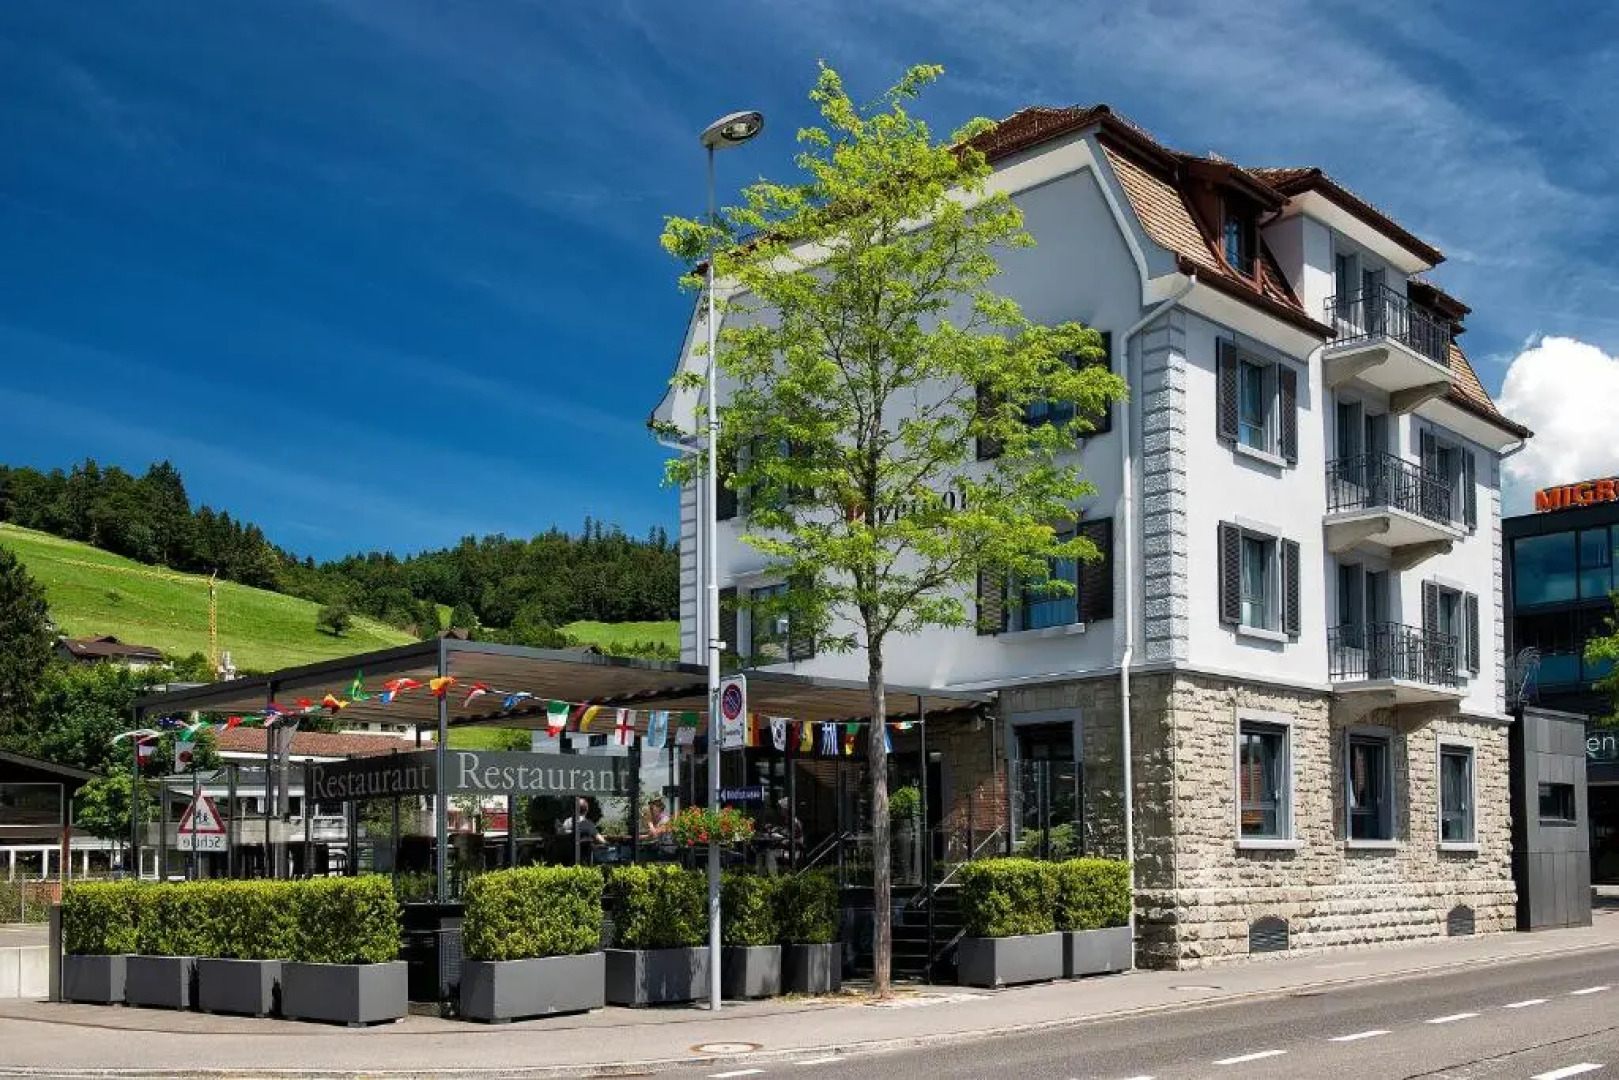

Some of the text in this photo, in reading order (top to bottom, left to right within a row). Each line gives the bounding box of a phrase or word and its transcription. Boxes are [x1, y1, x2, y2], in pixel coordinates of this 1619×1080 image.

[1534, 479, 1619, 512] MIGR
[311, 762, 430, 798] Restaurant
[457, 752, 629, 791] Restaurant
